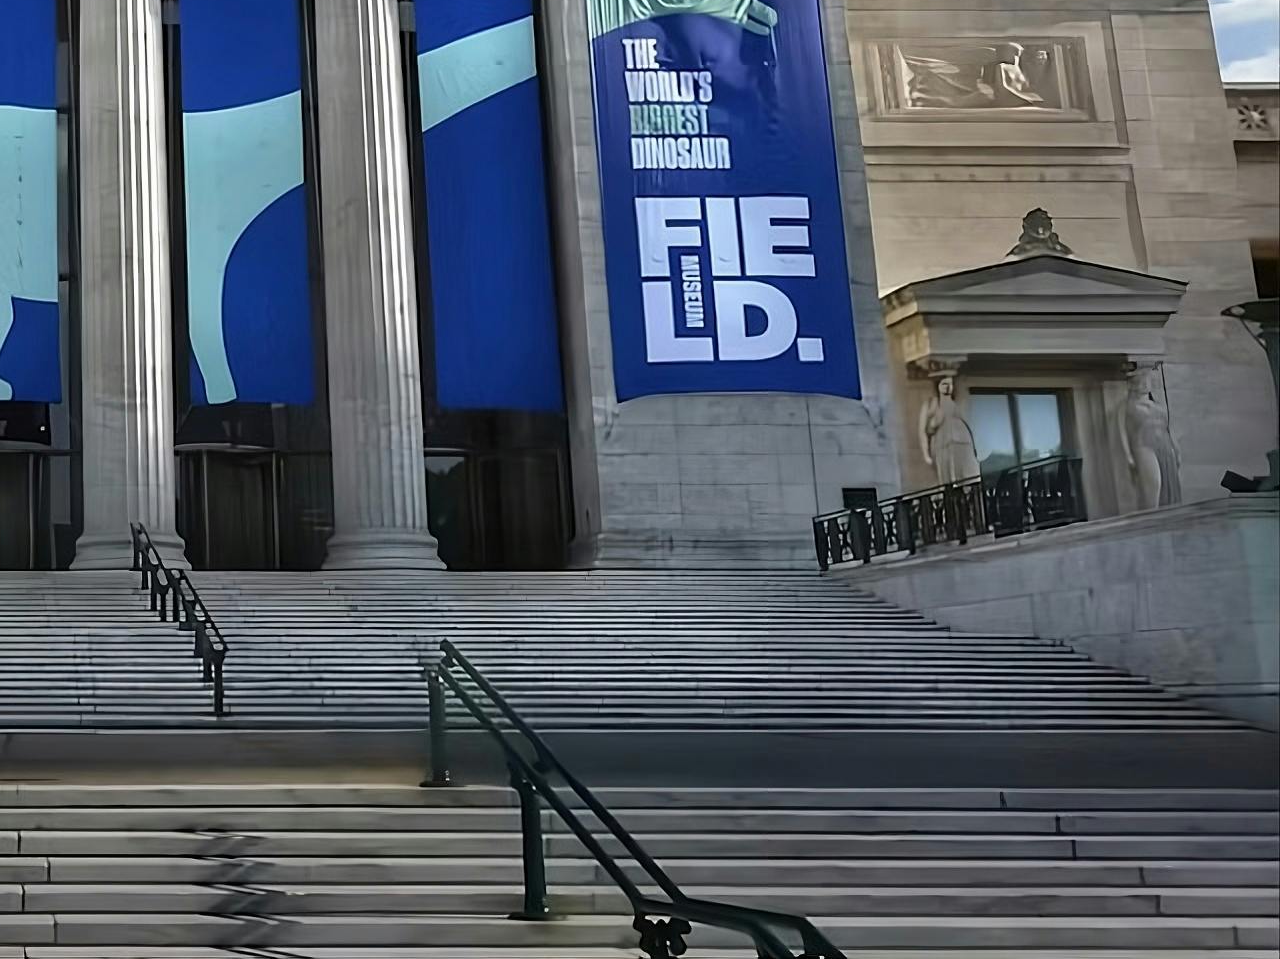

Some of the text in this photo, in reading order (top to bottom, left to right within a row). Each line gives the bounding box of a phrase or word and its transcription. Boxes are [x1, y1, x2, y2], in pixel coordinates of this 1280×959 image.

[621, 38, 660, 70] THE
[624, 71, 713, 103] WORLD'S
[628, 104, 709, 135] BIGGEST
[631, 137, 731, 169] DINOSAUR
[680, 254, 705, 328] MUSEUM
